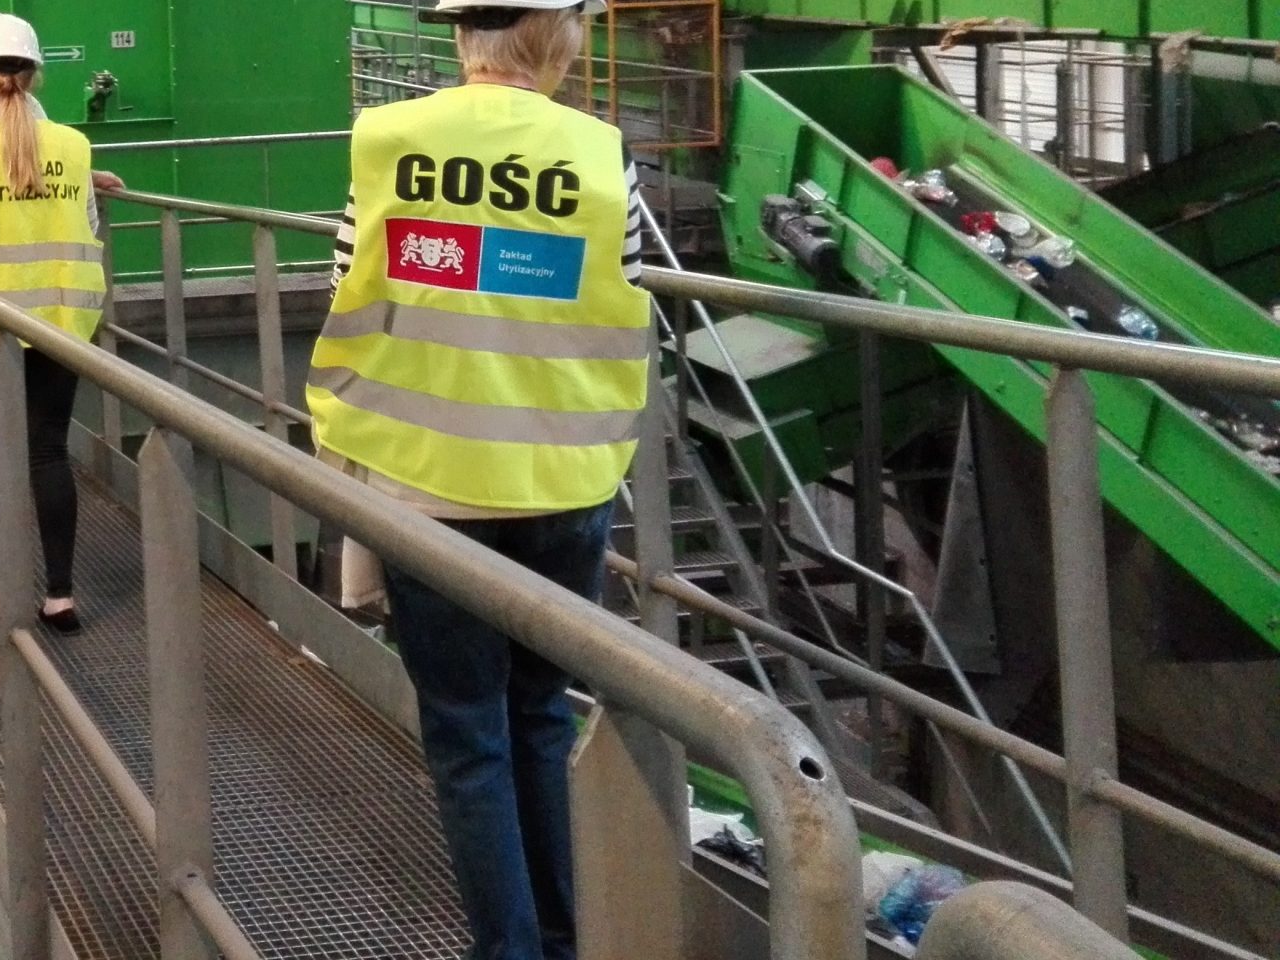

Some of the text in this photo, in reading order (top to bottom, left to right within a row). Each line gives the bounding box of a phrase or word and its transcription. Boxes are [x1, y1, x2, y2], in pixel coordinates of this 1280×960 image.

[395, 153, 580, 218] GOŚĆ
[499, 249, 532, 261] Zakład
[498, 263, 556, 278] Utylizacyjny
